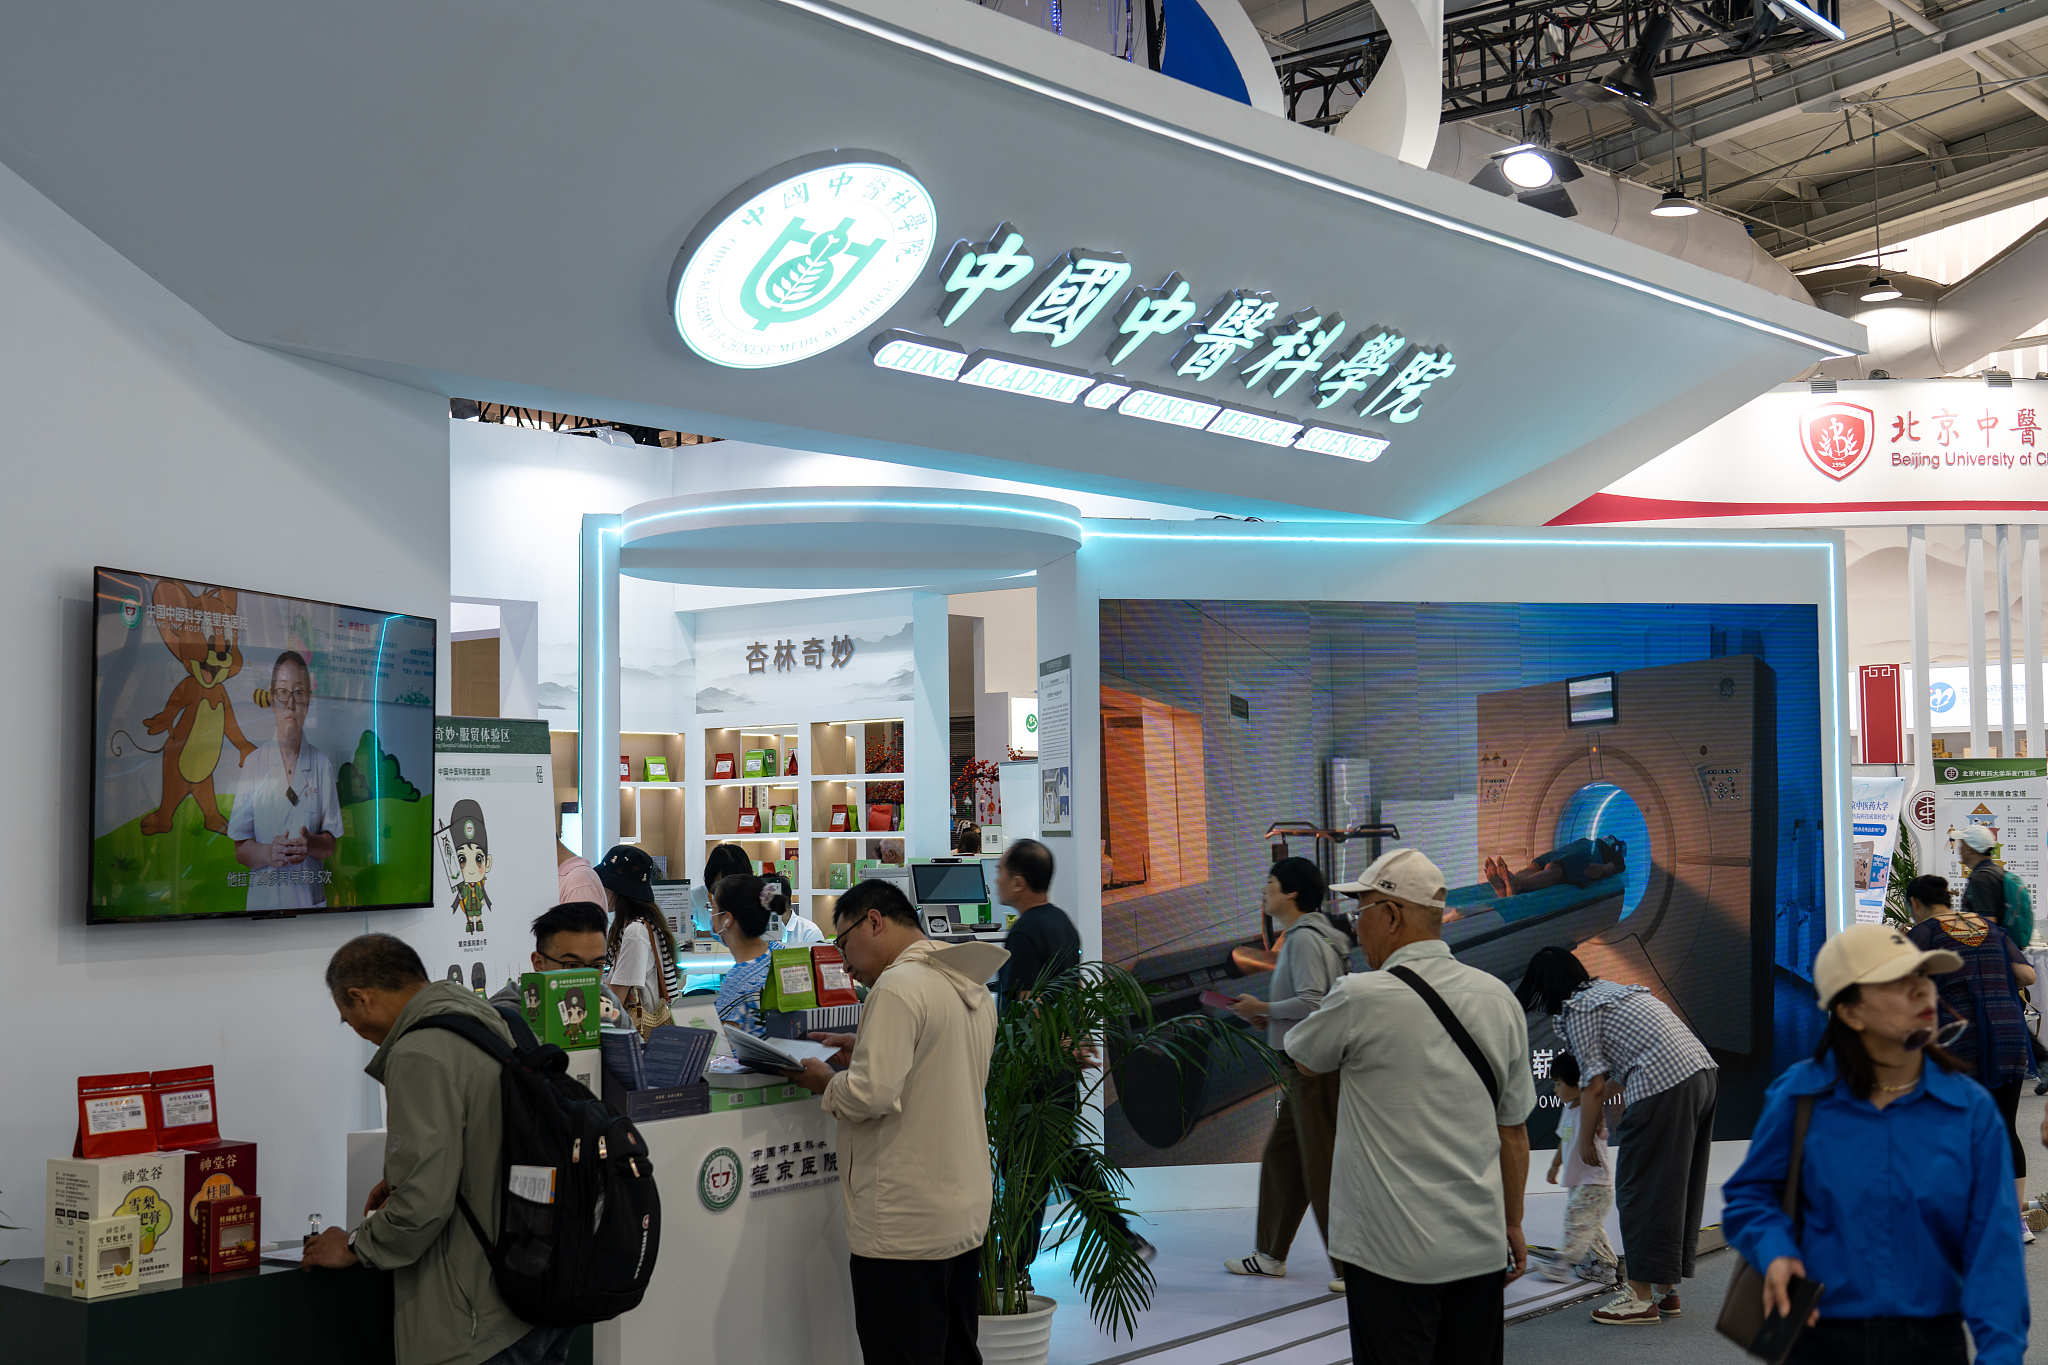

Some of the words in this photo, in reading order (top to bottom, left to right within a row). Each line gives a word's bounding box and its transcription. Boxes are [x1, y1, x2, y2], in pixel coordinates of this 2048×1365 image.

[741, 171, 928, 263] 中國中醫科學院
[703, 238, 736, 275] CHINA
[944, 231, 1457, 424] 中國中醫科學院
[877, 343, 960, 379] CHINA
[965, 360, 1091, 400] ACADEMY
[1087, 385, 1127, 407] OF
[1121, 391, 1217, 428] CHINESE
[1210, 410, 1300, 446] MEDICAL
[1299, 428, 1387, 460] SCIENCES
[1891, 453, 1941, 469] Beijing
[1945, 452, 2016, 469] University
[2019, 452, 2032, 466] of
[146, 602, 249, 631] 中国中医科学院望京医院
[745, 634, 855, 674] 杏林奇妙
[1954, 790, 2027, 798] 中国居民平衡膳食宝塔
[122, 1165, 163, 1184] 神堂谷
[199, 1154, 238, 1172] 神堂谷
[752, 1151, 839, 1186] 望京医院
[752, 1187, 782, 1198] WANGJING
[784, 1180, 811, 1191] HOSPITAL
[813, 1178, 821, 1186] OF
[128, 1195, 155, 1212] 雪梨
